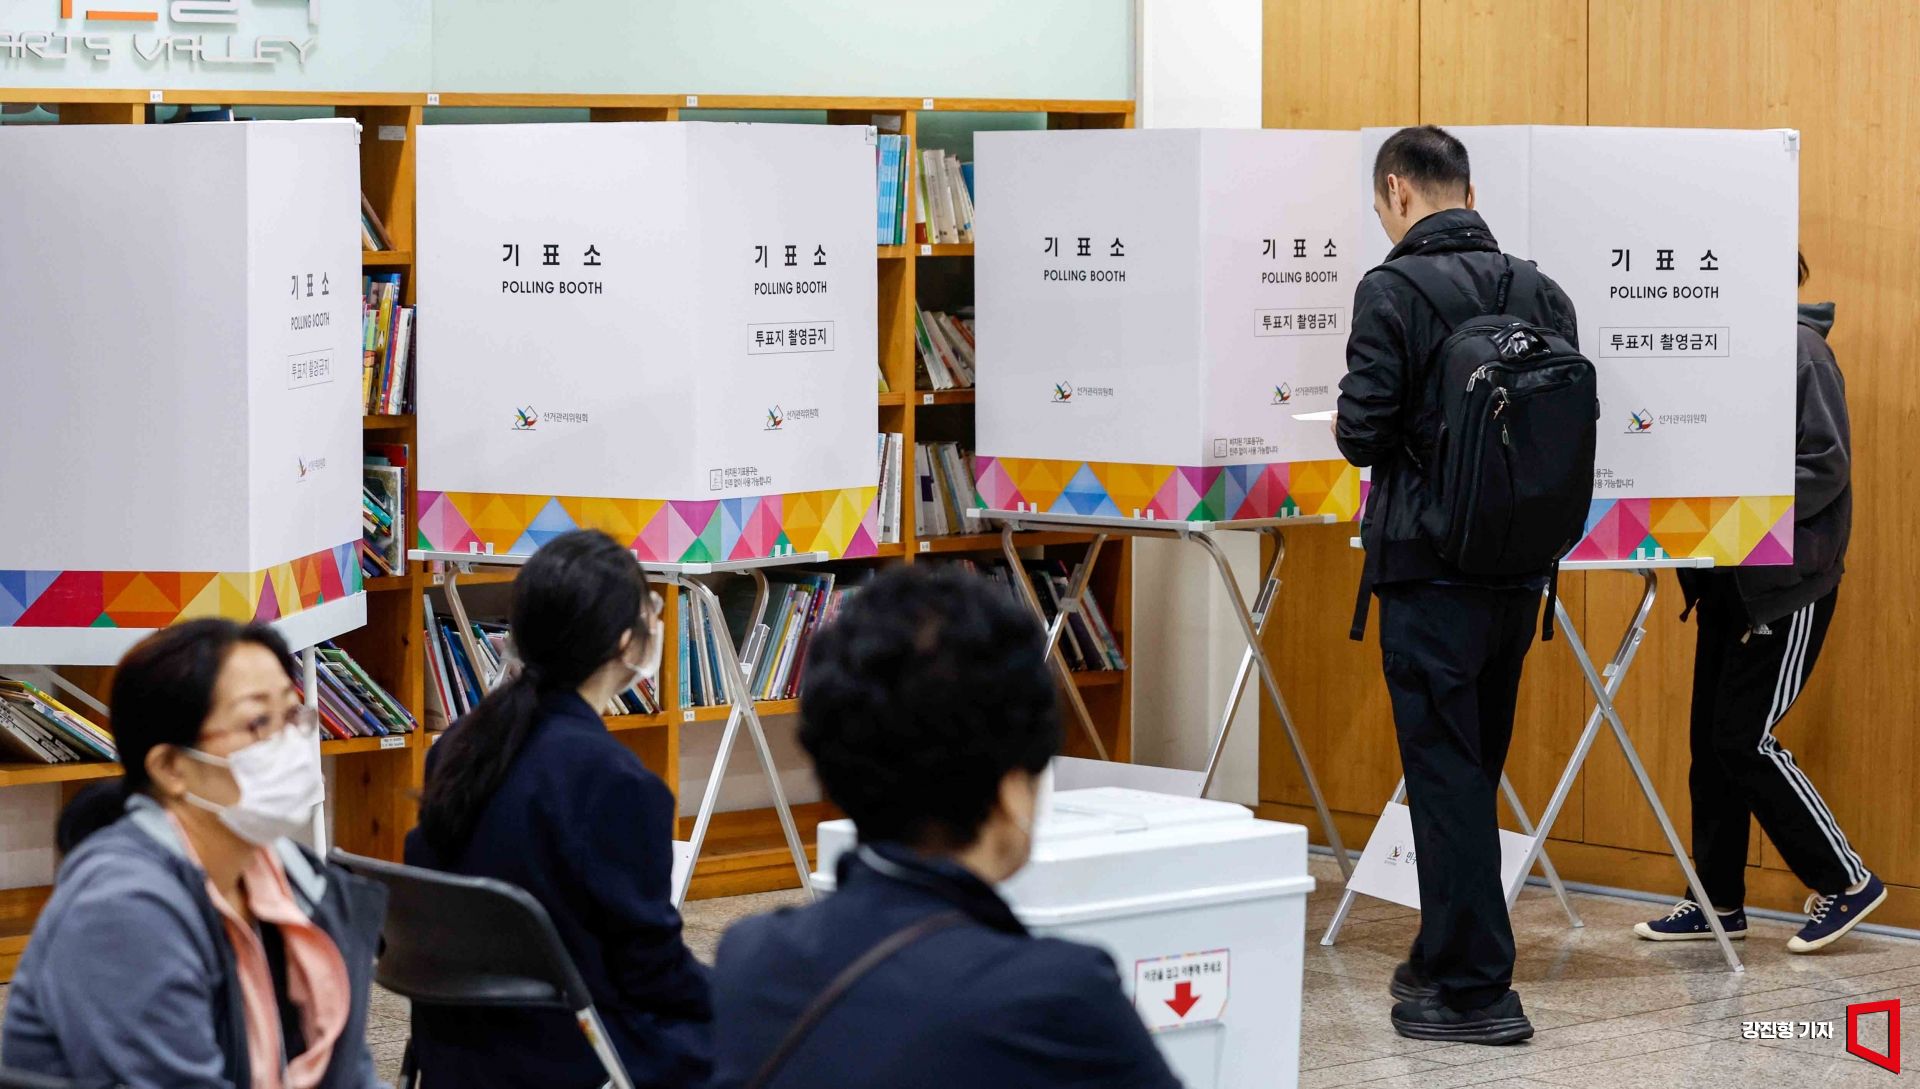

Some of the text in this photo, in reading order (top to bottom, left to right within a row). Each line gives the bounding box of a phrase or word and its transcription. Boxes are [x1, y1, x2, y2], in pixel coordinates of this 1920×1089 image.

[132, 33, 318, 64] VALLEY
[1043, 269, 1126, 282] POLLING BOOTH
[1261, 270, 1338, 284] POLLING BOOTH
[502, 280, 603, 295] POLLING BOOTH
[754, 280, 827, 296] POLLING BOOTH
[1610, 285, 1719, 299] POLLING BOOTH
[1262, 313, 1337, 331] 투표지 촬영금지
[755, 327, 827, 348] 투표지 촬영금지
[1610, 333, 1717, 352] 투표지 촬영금지
[543, 412, 589, 423] 선거관리위원회
[1658, 413, 1707, 425] 선거관리위원회
